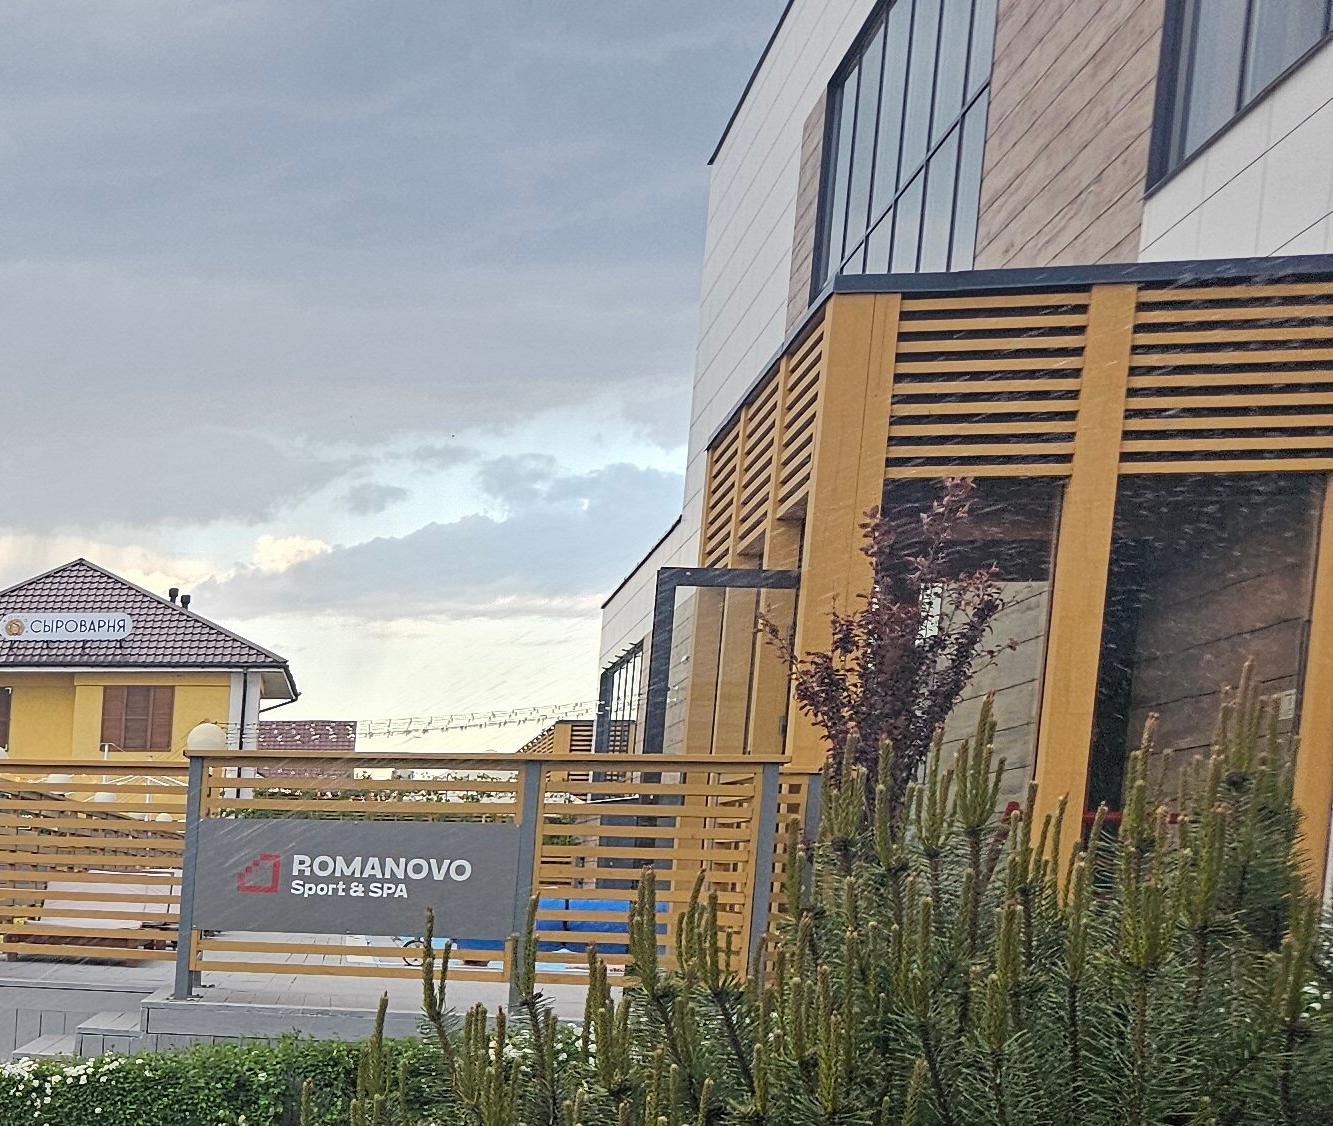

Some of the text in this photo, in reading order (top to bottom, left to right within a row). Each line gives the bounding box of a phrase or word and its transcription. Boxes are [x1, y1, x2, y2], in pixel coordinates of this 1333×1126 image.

[30, 619, 126, 633] СЫРОВАРНЯ
[292, 854, 472, 881] ROMANOVO
[290, 880, 408, 899] Sport & SPA
